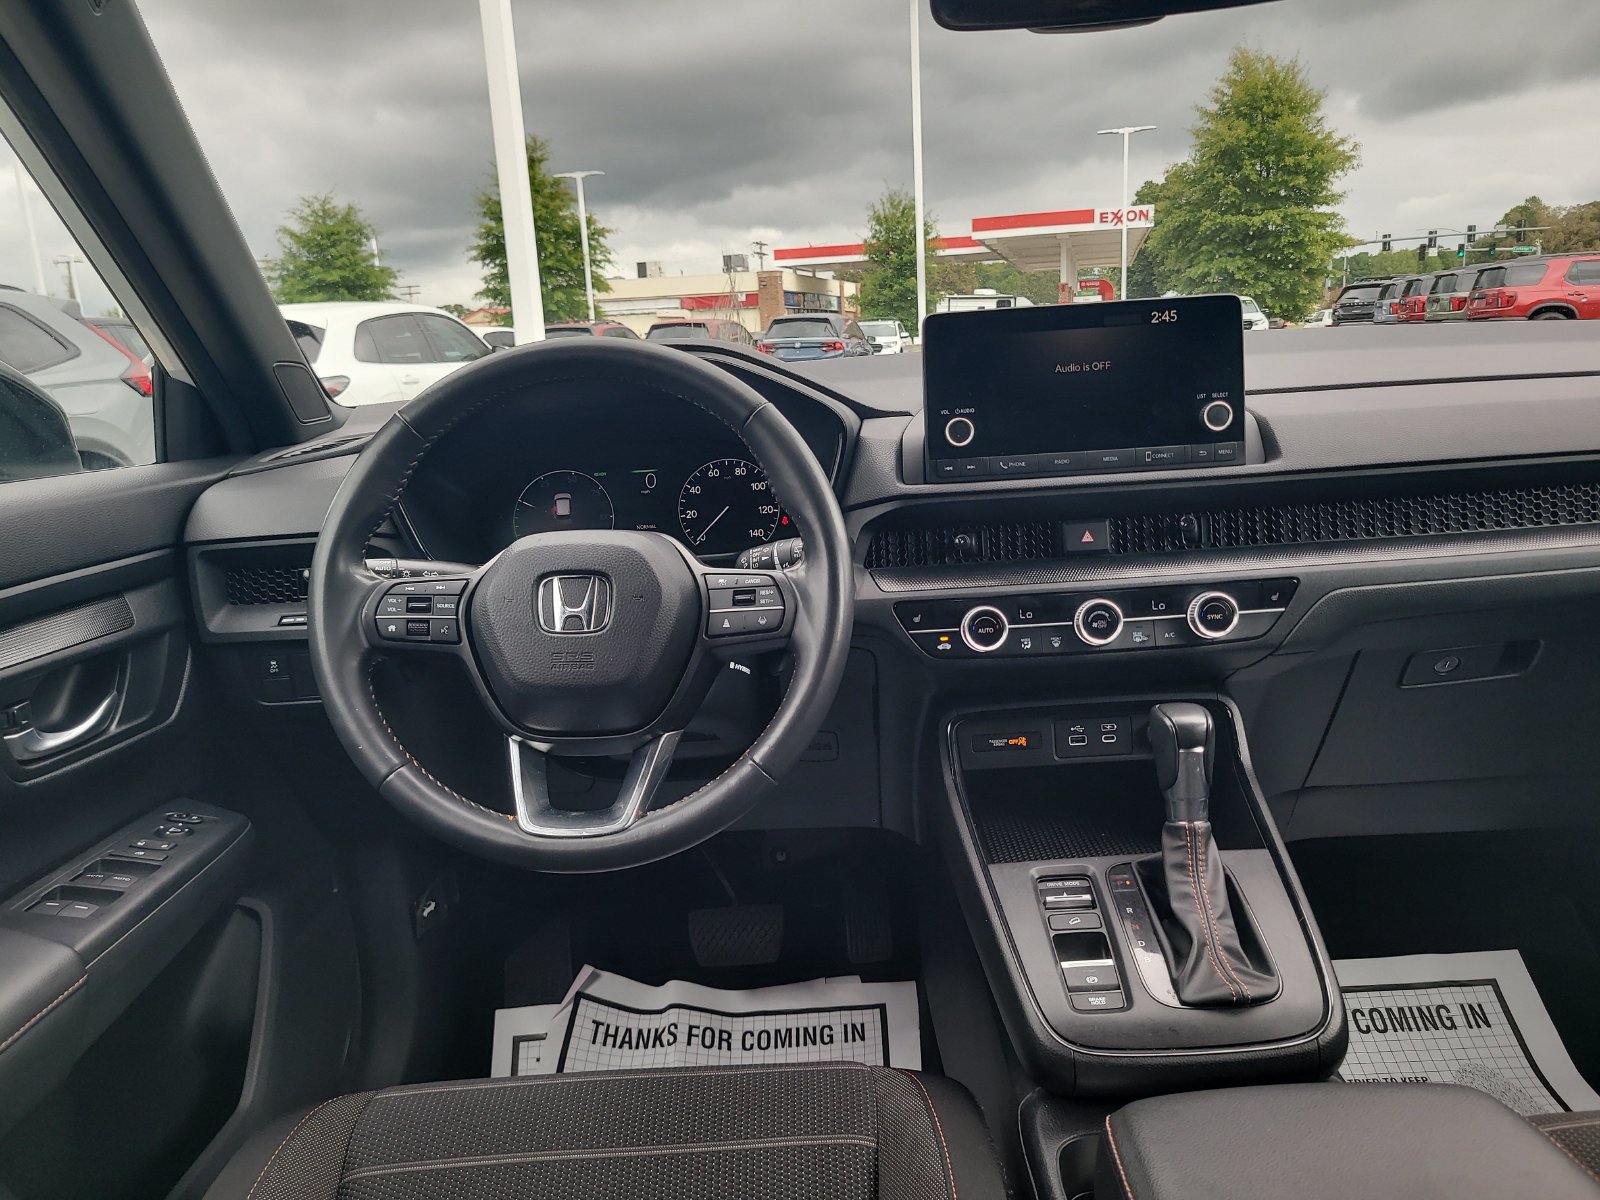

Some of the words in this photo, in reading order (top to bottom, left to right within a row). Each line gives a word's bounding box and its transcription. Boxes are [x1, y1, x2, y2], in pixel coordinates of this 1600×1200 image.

[1099, 208, 1149, 226] EXXON
[1151, 310, 1178, 323] 2:45
[1055, 363, 1081, 373] Audio
[1083, 362, 1090, 371] is
[1092, 361, 1111, 371] OFF
[708, 468, 720, 477] 60
[734, 467, 747, 476] 80
[645, 472, 657, 489] 0
[689, 485, 701, 495] 40
[750, 481, 767, 491] 100
[685, 510, 698, 519] 20
[758, 505, 774, 514] 120
[749, 528, 765, 538] 140
[1152, 600, 1166, 611] Lo
[1019, 609, 1033, 619] Lo
[551, 652, 594, 661] SRS
[550, 662, 595, 671] AIRBAG
[1351, 1004, 1457, 1035] COMING
[1460, 1002, 1492, 1030] IN
[590, 1020, 678, 1050] THANKS
[686, 1025, 732, 1051] FOR
[741, 1024, 834, 1051] COMING
[843, 1022, 866, 1043] IN
